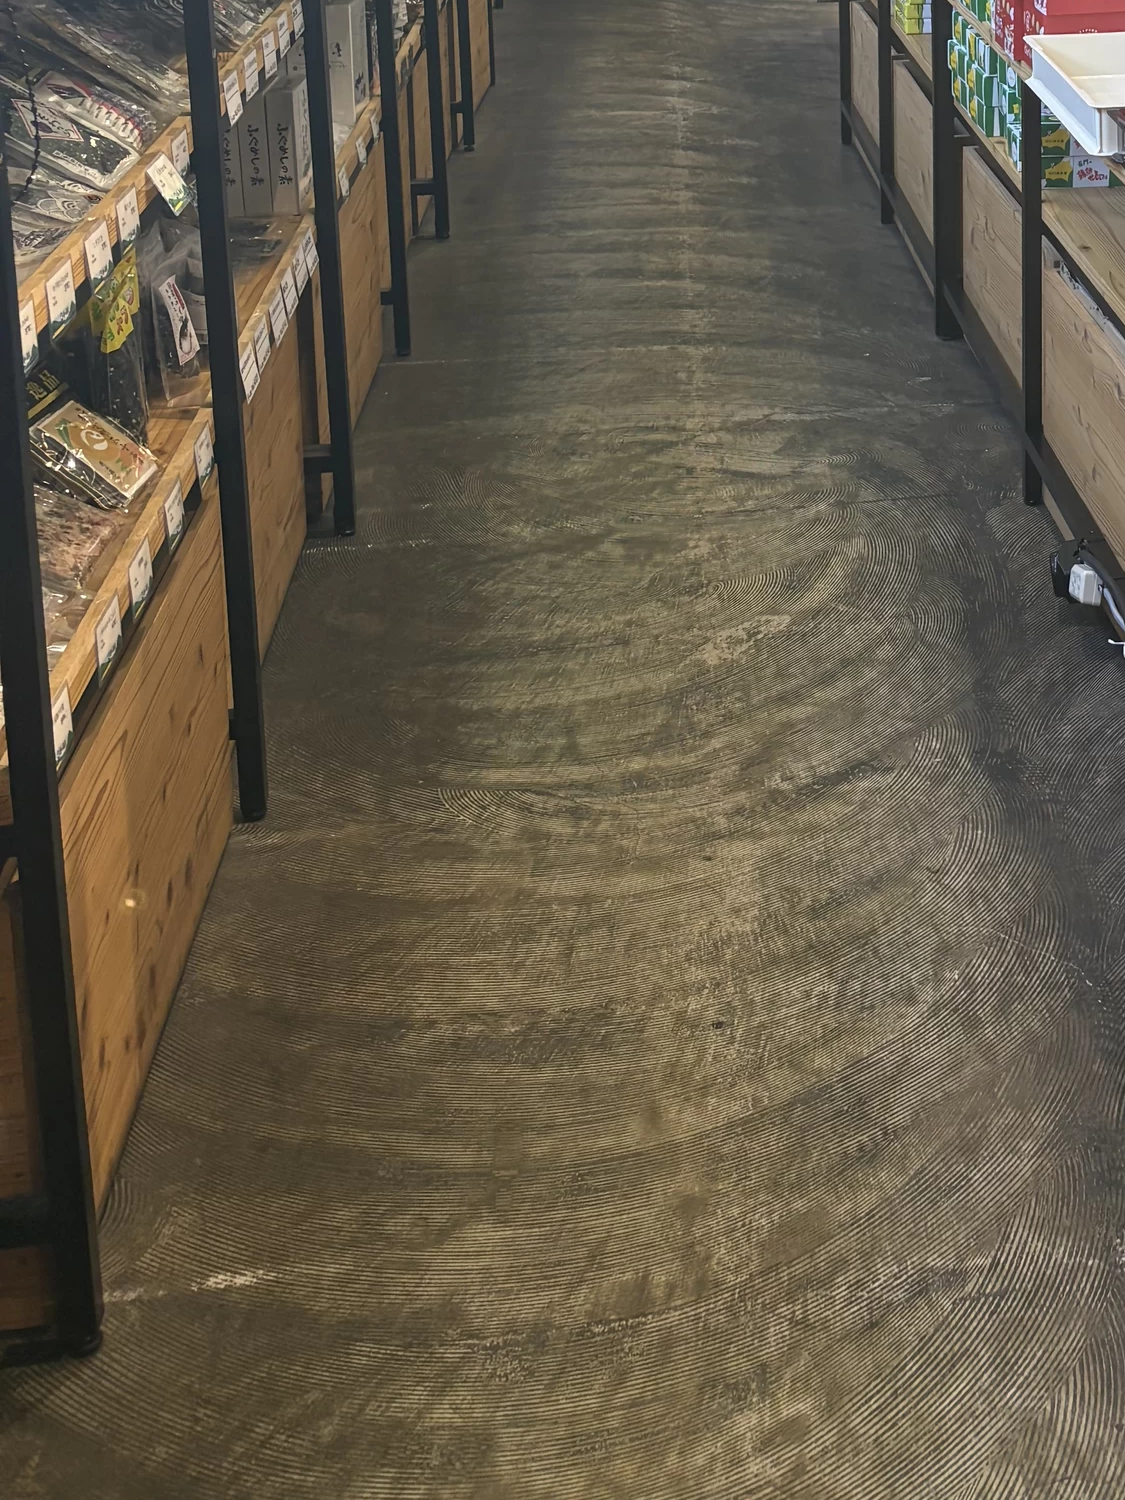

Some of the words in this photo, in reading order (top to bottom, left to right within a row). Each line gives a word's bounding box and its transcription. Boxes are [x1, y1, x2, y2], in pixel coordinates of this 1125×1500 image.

[277, 123, 293, 185] ふくめしの素
